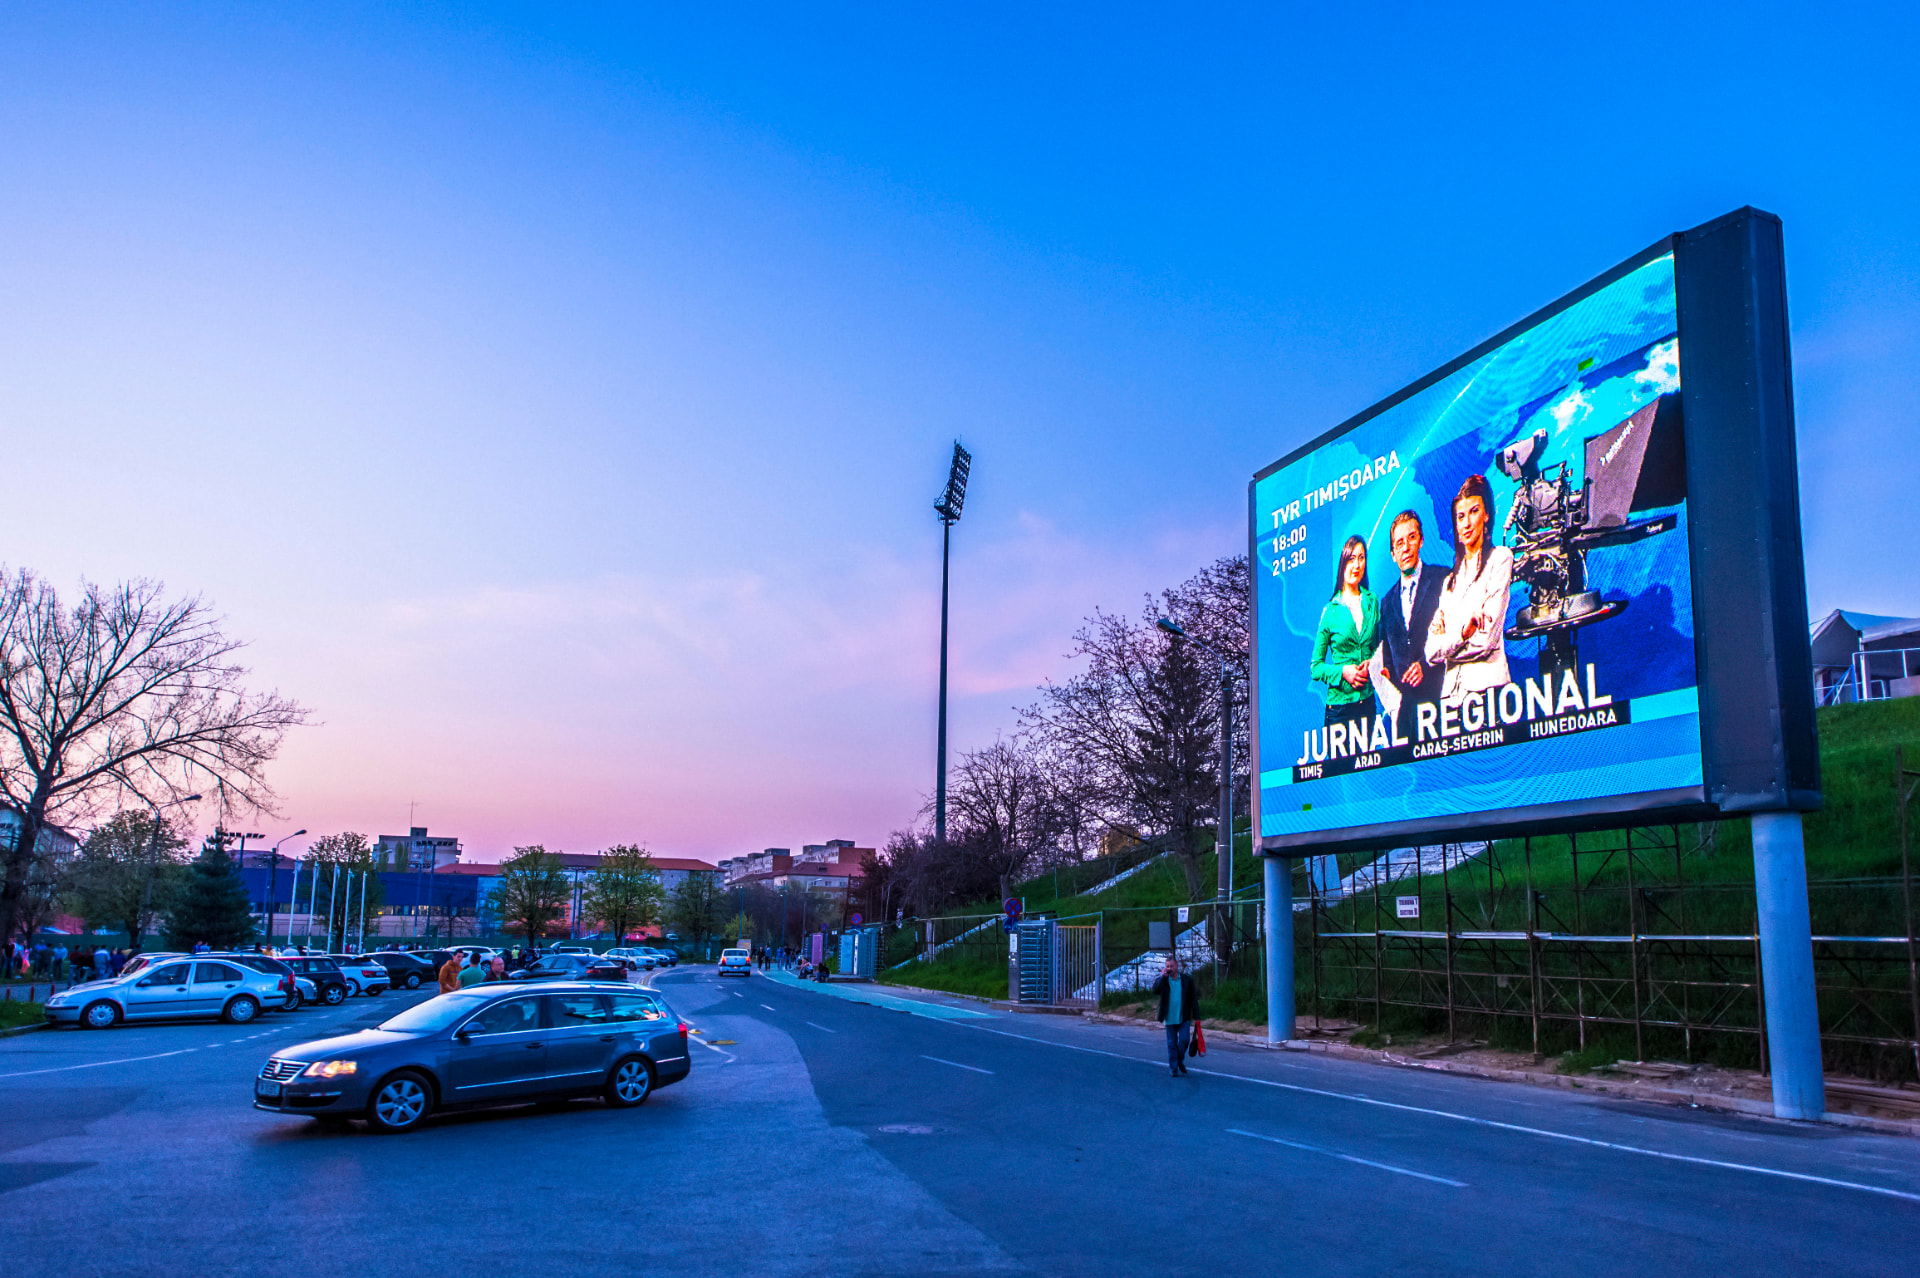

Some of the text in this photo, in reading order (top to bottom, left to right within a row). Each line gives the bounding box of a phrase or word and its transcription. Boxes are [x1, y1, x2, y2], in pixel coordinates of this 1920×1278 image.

[1271, 450, 1401, 529] TVR TIMIȘOARA
[1272, 524, 1307, 554] 18:00
[1272, 547, 1307, 577] 21:30
[1296, 663, 1613, 766] JURNAL REGIONAL
[1299, 708, 1618, 779] TIMIȘ ARAD CARAȘ-SEVERIN HUNEDOARA
